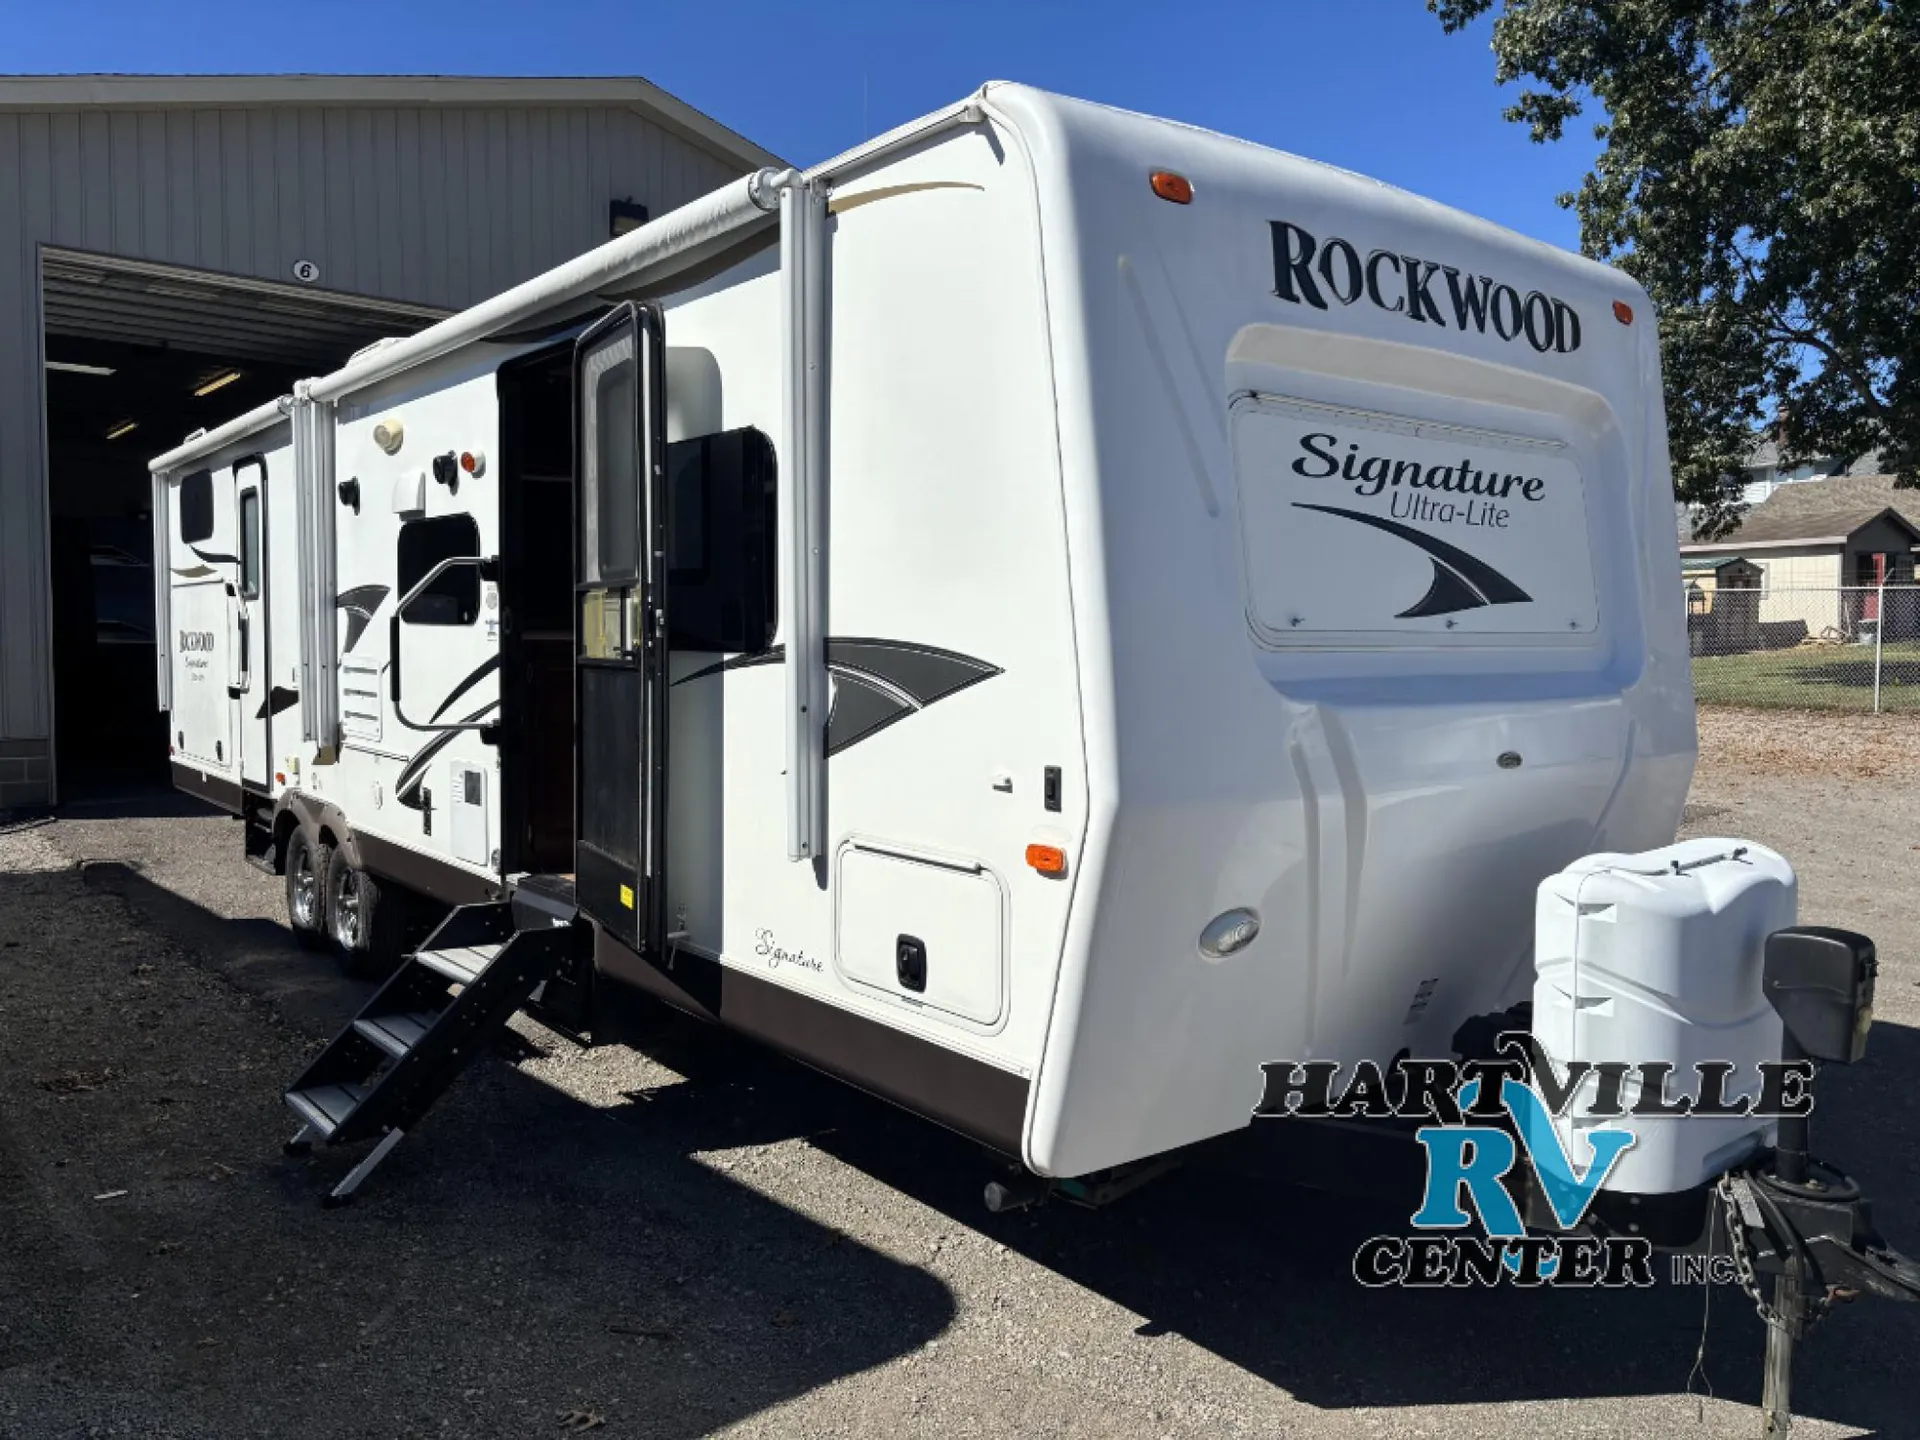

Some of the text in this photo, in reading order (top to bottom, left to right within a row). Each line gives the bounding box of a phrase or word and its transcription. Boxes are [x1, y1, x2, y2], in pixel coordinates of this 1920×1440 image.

[300, 263, 311, 278] 6
[1267, 219, 1582, 353] ROCKWOOD
[1291, 432, 1546, 501] Signature
[1389, 491, 1511, 528] Ultra-Lite
[755, 927, 824, 973] Signature
